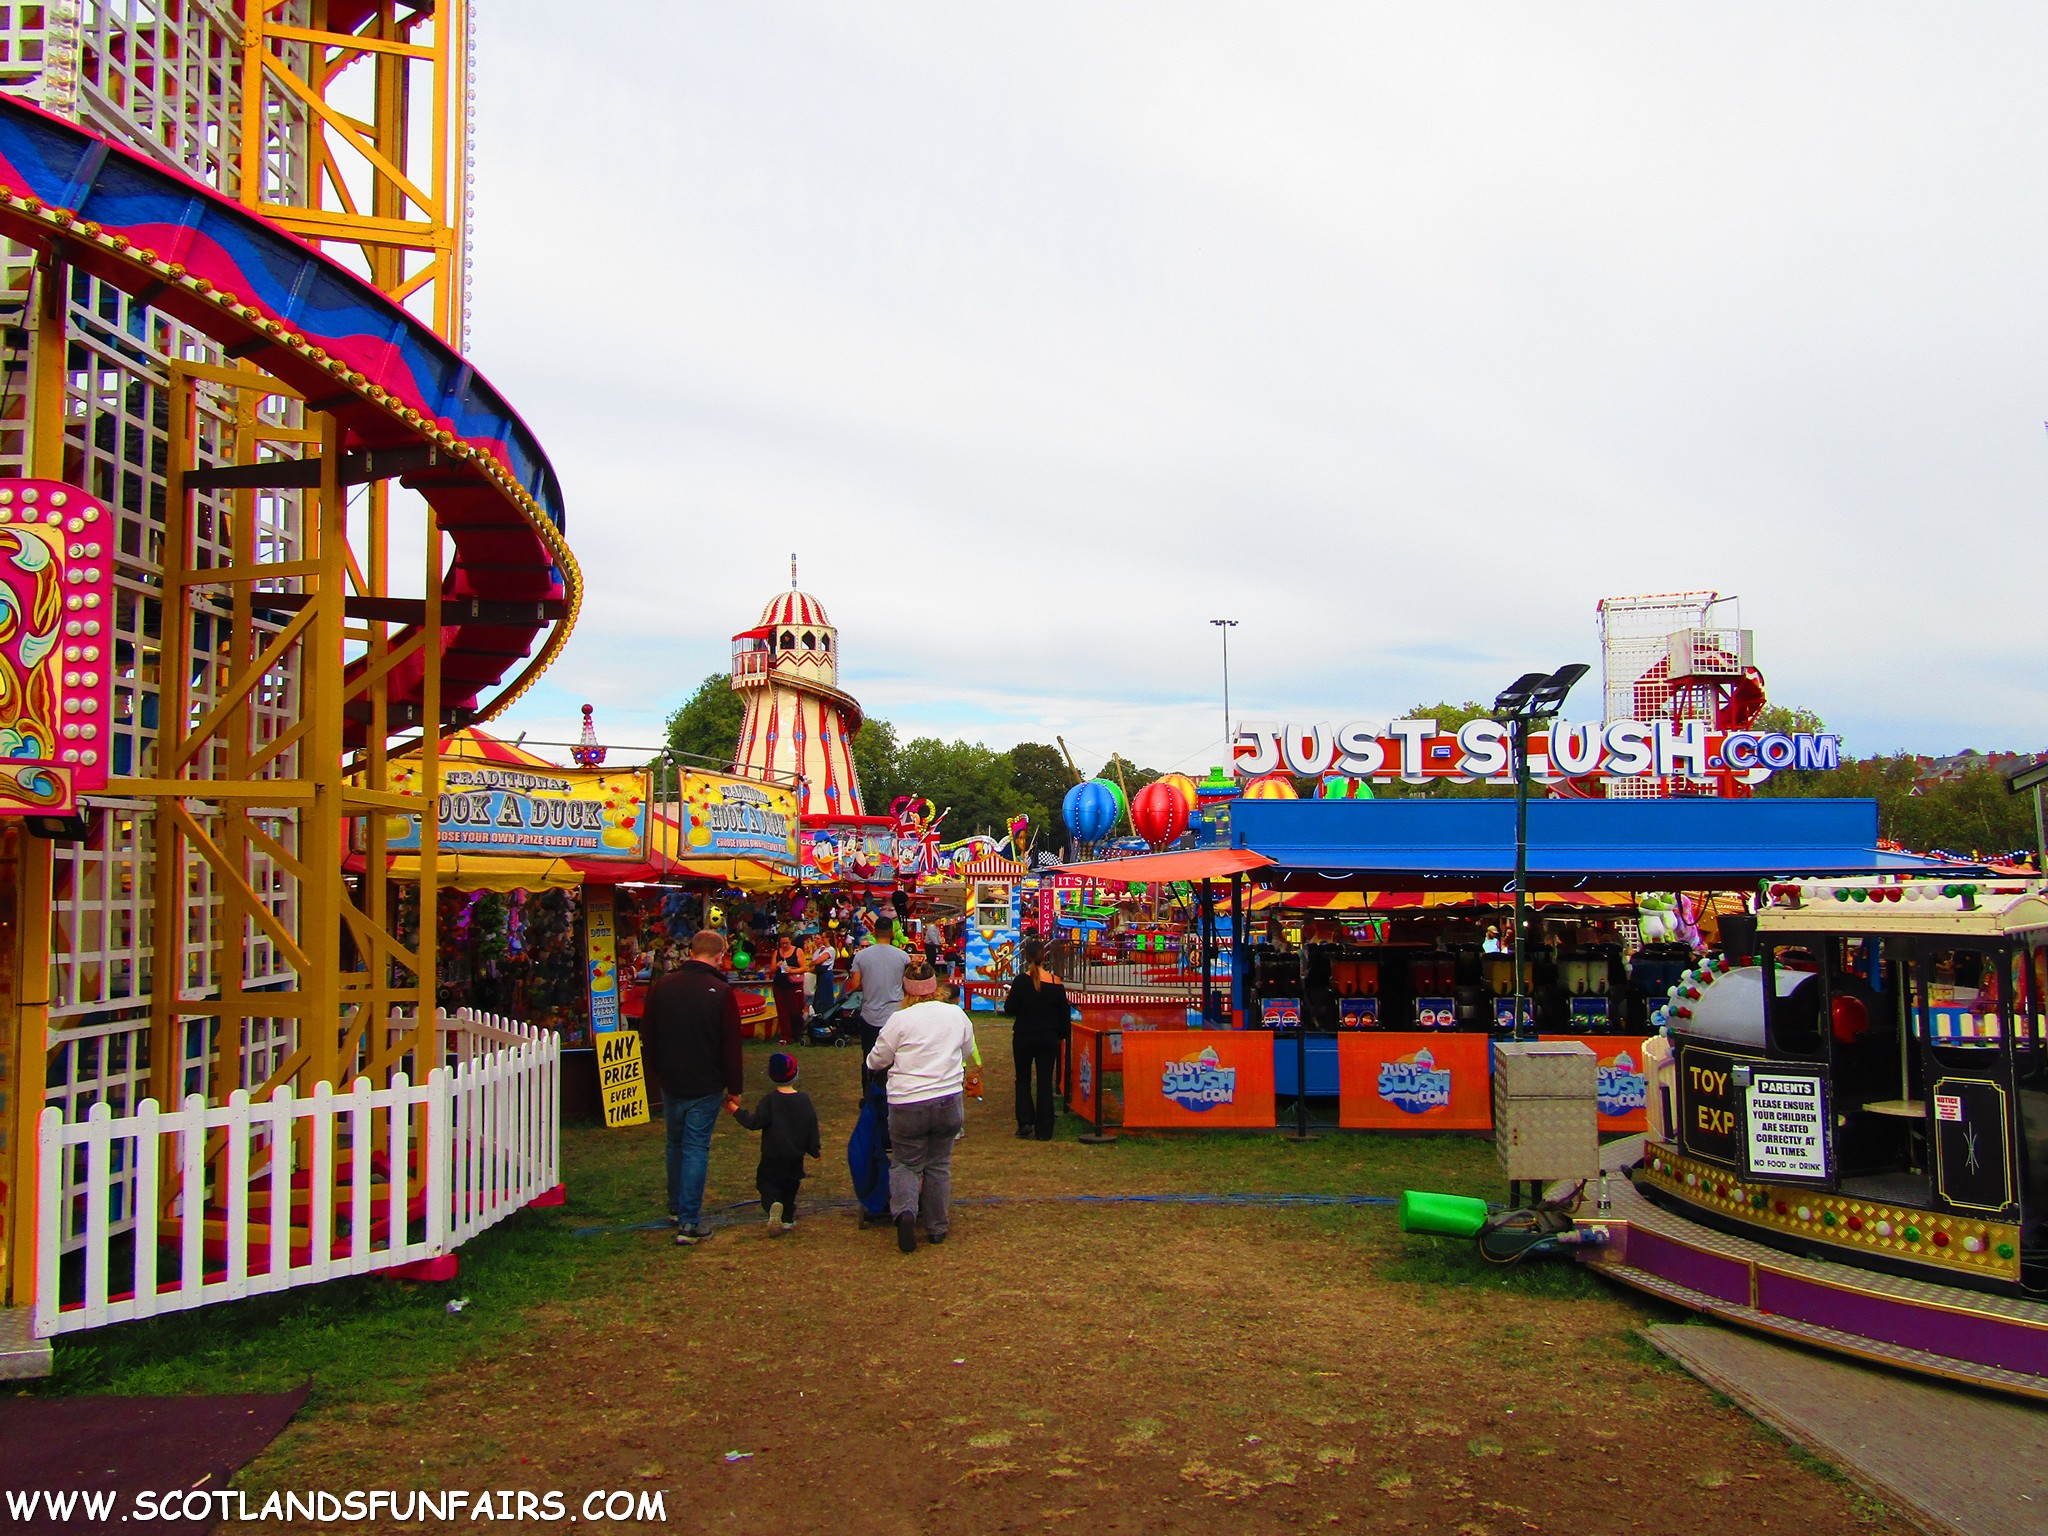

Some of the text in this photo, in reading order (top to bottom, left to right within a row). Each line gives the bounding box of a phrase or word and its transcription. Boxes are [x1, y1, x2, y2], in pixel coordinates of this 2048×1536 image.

[448, 771, 572, 791] TRADITIONAL
[412, 793, 604, 831] OOK A DUCK
[710, 803, 749, 833] HOOK
[462, 831, 490, 843] YOUR
[491, 833, 516, 844] OWN
[517, 834, 544, 845] PRIZE
[545, 836, 574, 847] EVERY
[575, 837, 598, 848] TIME
[1058, 876, 1106, 886] IT'S AL
[602, 1035, 635, 1064] ANY
[604, 1061, 640, 1085] PRIZE
[1162, 1067, 1235, 1094] SLUSH
[1378, 1069, 1450, 1095] SLUSH
[1689, 1066, 1728, 1096] TOY
[610, 1085, 638, 1103] EVERY
[1761, 1081, 1812, 1094] PARENTS
[608, 1100, 643, 1123] TIME!
[1752, 1099, 1815, 1111] PLEASE ENSURE
[1698, 1105, 1735, 1135] EXP
[1752, 1110, 1817, 1122] YOUR CHILDREN
[1762, 1123, 1809, 1134] ARE SEATED
[1756, 1134, 1815, 1146] CORRECTLY AT
[1765, 1145, 1808, 1157] ALL TIMES.
[1754, 1159, 1764, 1167] NO
[1767, 1160, 1787, 1168] FOOD
[1798, 1162, 1821, 1171] DRINK
